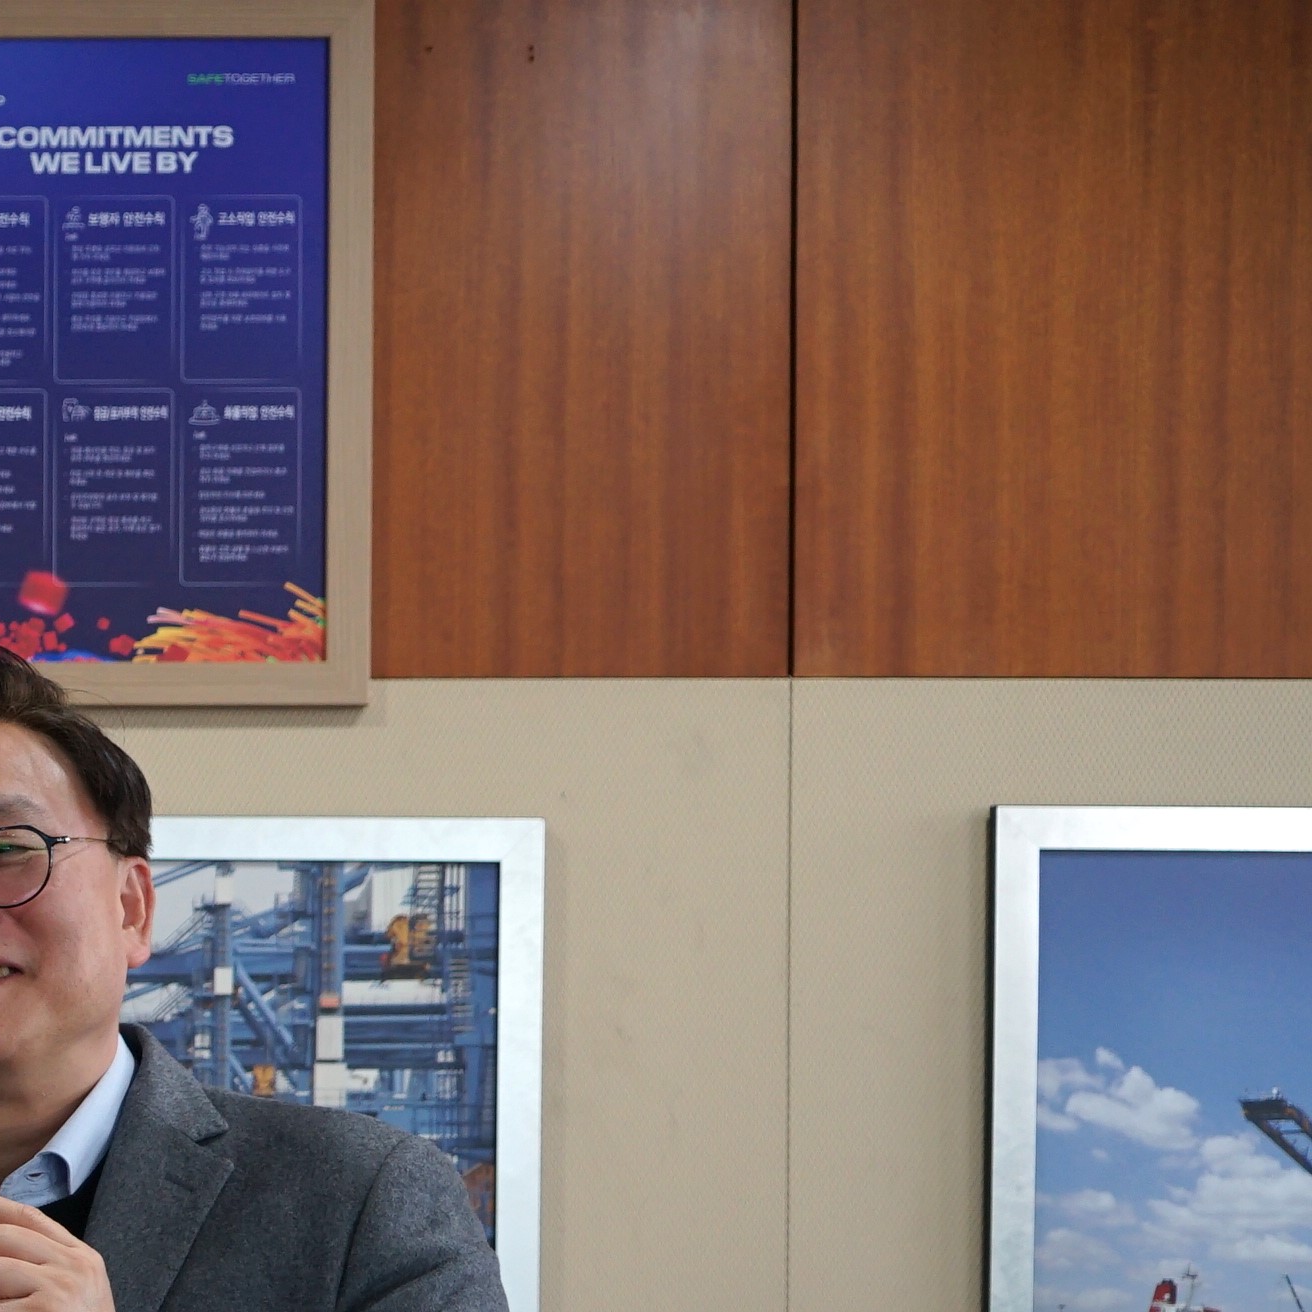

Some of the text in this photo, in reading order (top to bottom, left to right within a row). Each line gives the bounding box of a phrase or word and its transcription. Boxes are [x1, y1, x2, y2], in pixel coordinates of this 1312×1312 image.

[29, 151, 198, 174] WE LIVE BY
[87, 211, 166, 228] 보행자 안전수칙
[257, 211, 296, 228] 안전수칙
